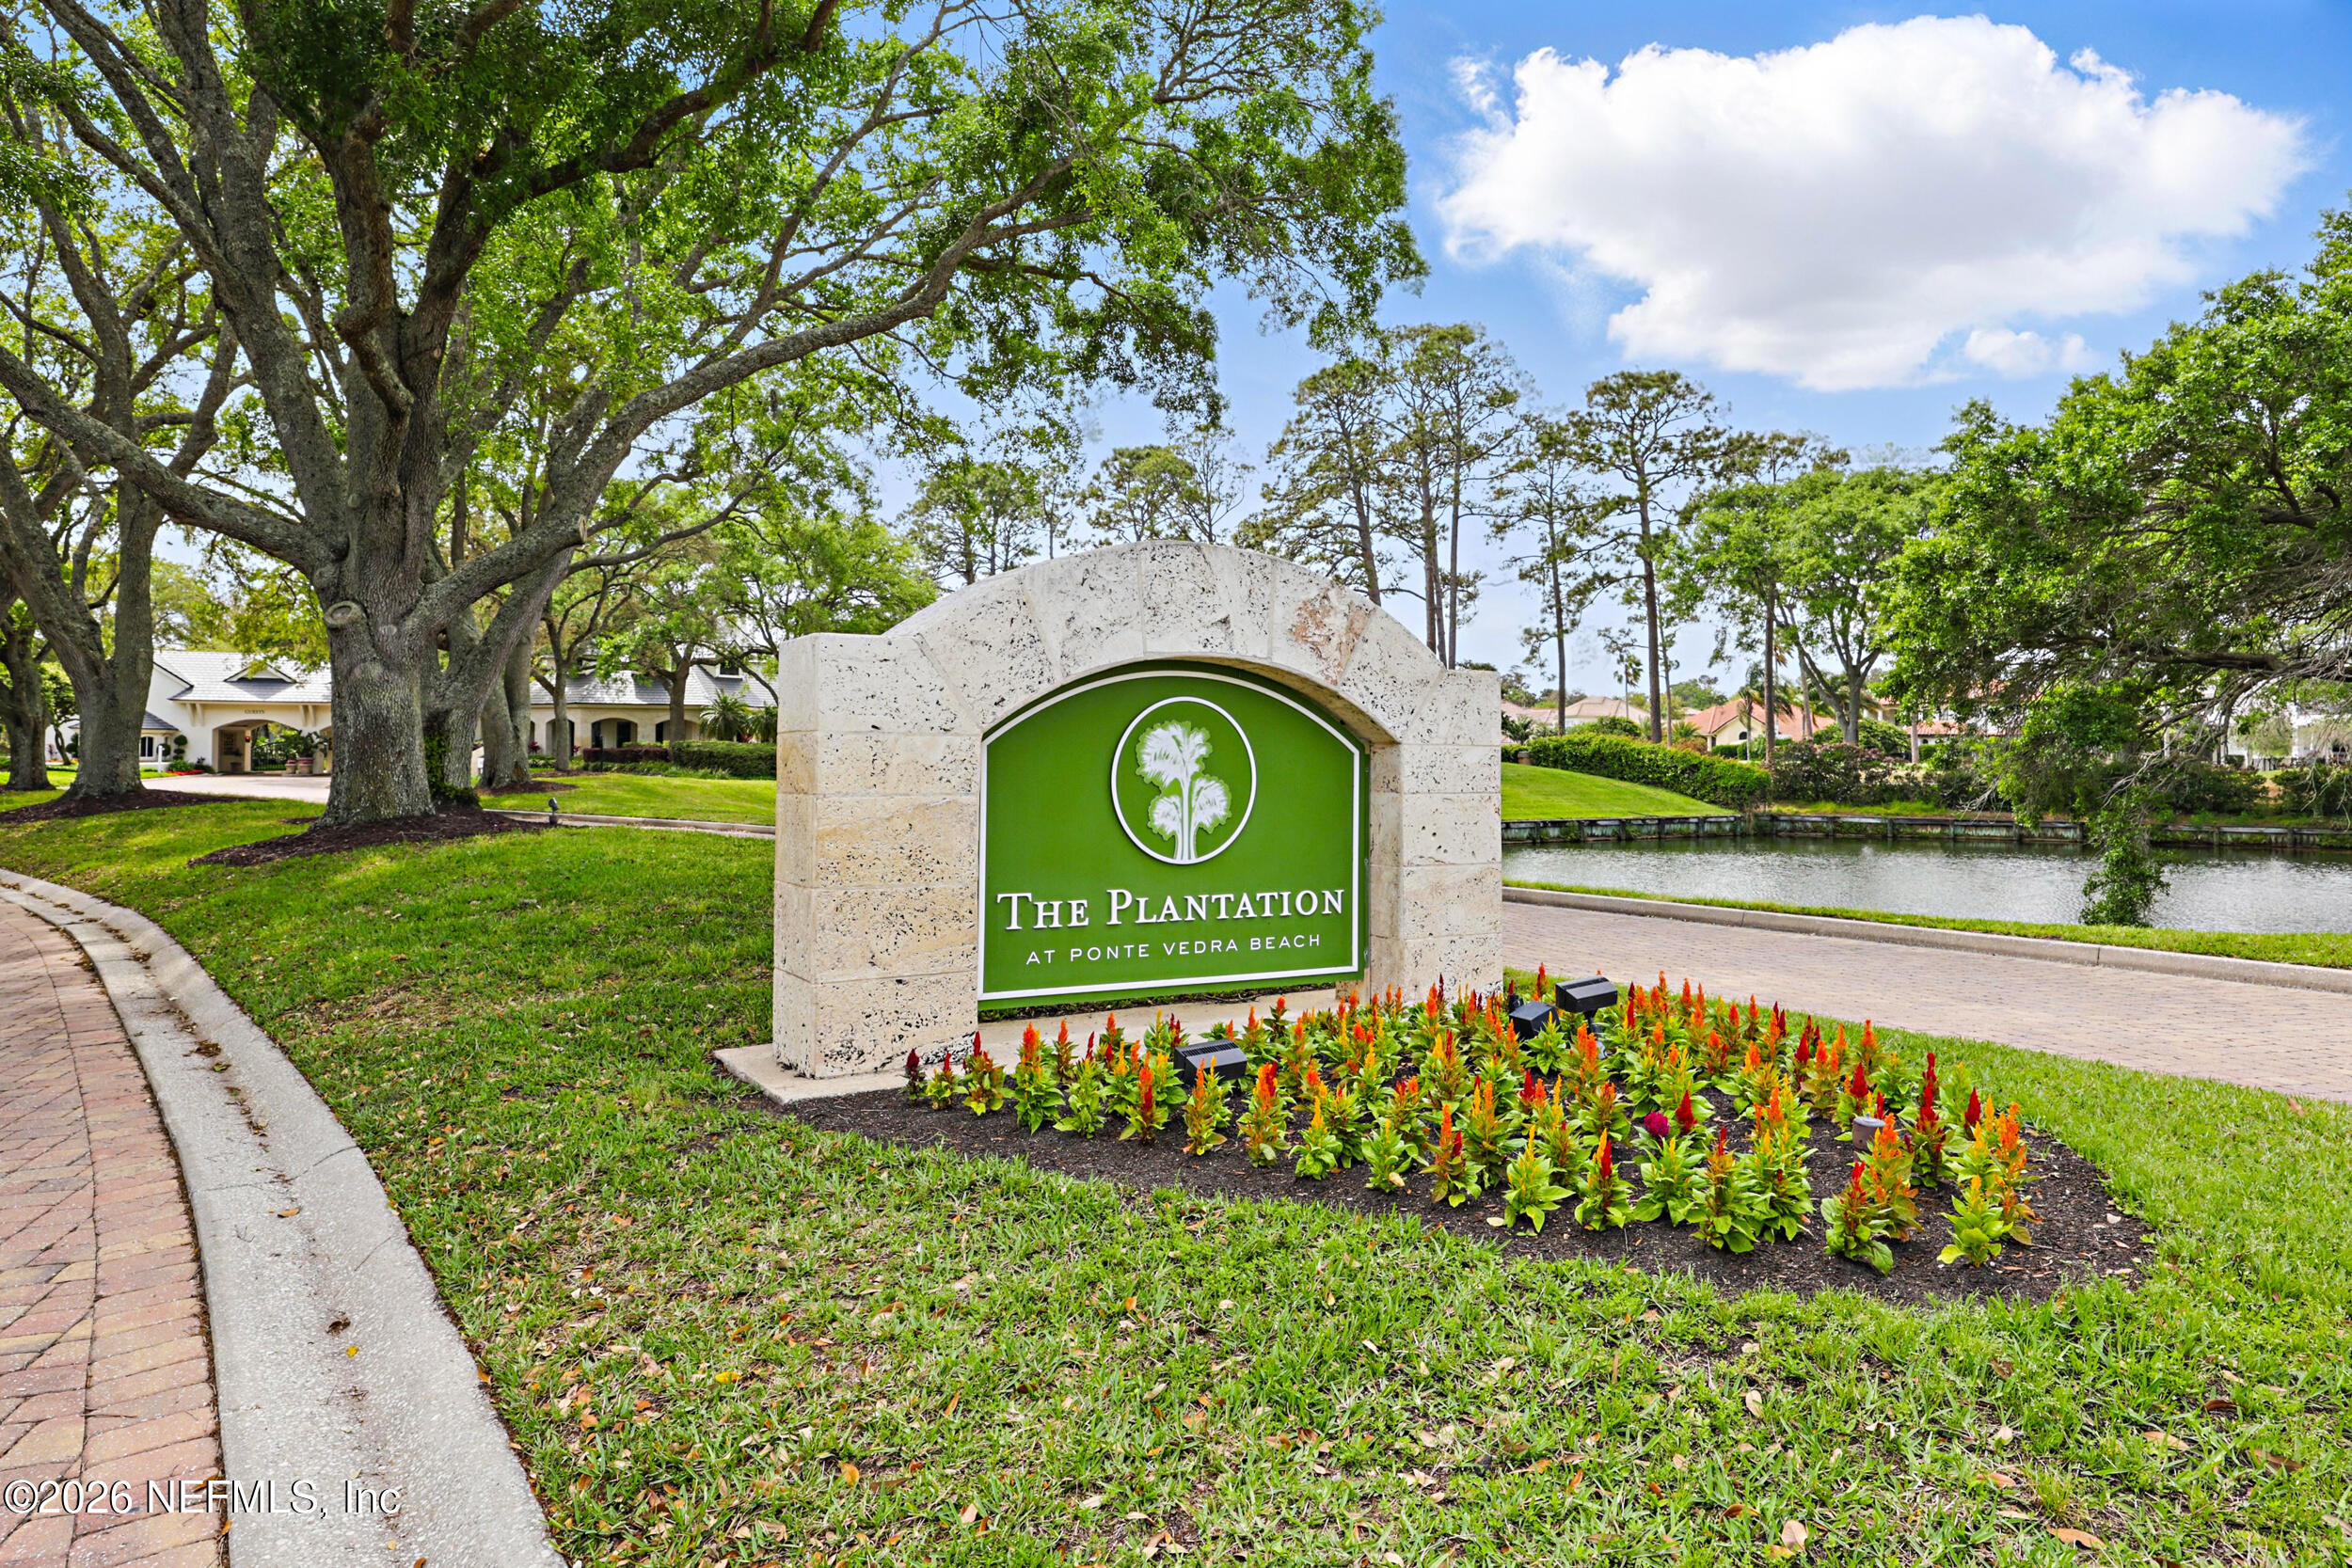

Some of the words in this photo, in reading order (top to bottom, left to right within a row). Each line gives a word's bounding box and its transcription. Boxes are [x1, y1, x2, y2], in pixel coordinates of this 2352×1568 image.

[1025, 950, 1056, 965] AT
[1070, 943, 1150, 962] PONTE
[1162, 939, 1239, 957] VEDRA
[1249, 934, 1321, 951] BEACH
